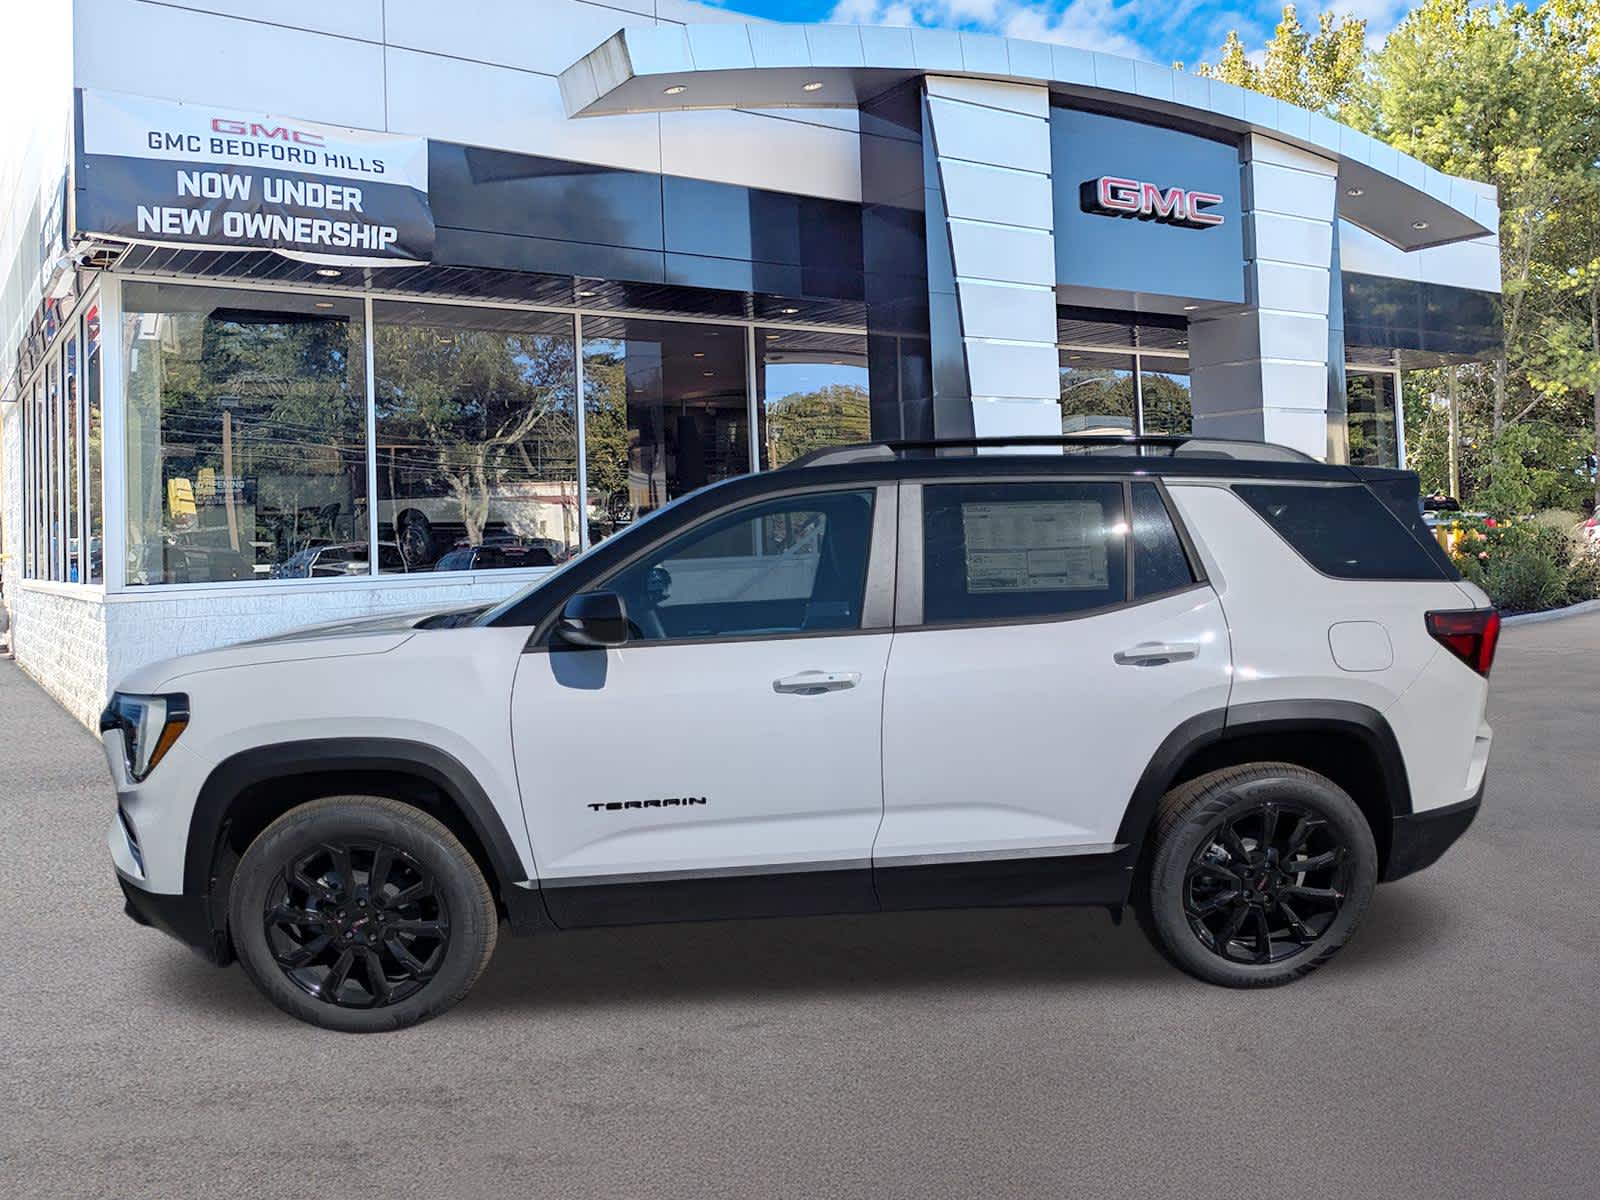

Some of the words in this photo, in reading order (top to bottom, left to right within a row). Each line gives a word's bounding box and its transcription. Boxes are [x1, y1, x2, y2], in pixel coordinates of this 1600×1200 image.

[148, 131, 201, 152] GMC
[210, 138, 316, 165] BEDFORD
[324, 153, 385, 174] HILLS
[211, 118, 325, 147] GMC
[177, 170, 252, 201] NOW
[263, 176, 363, 213] UNDER
[1096, 176, 1225, 225] GMC
[137, 205, 211, 236] NEW
[223, 210, 397, 250] OWNERSHIP
[587, 797, 706, 811] TERRAIN
